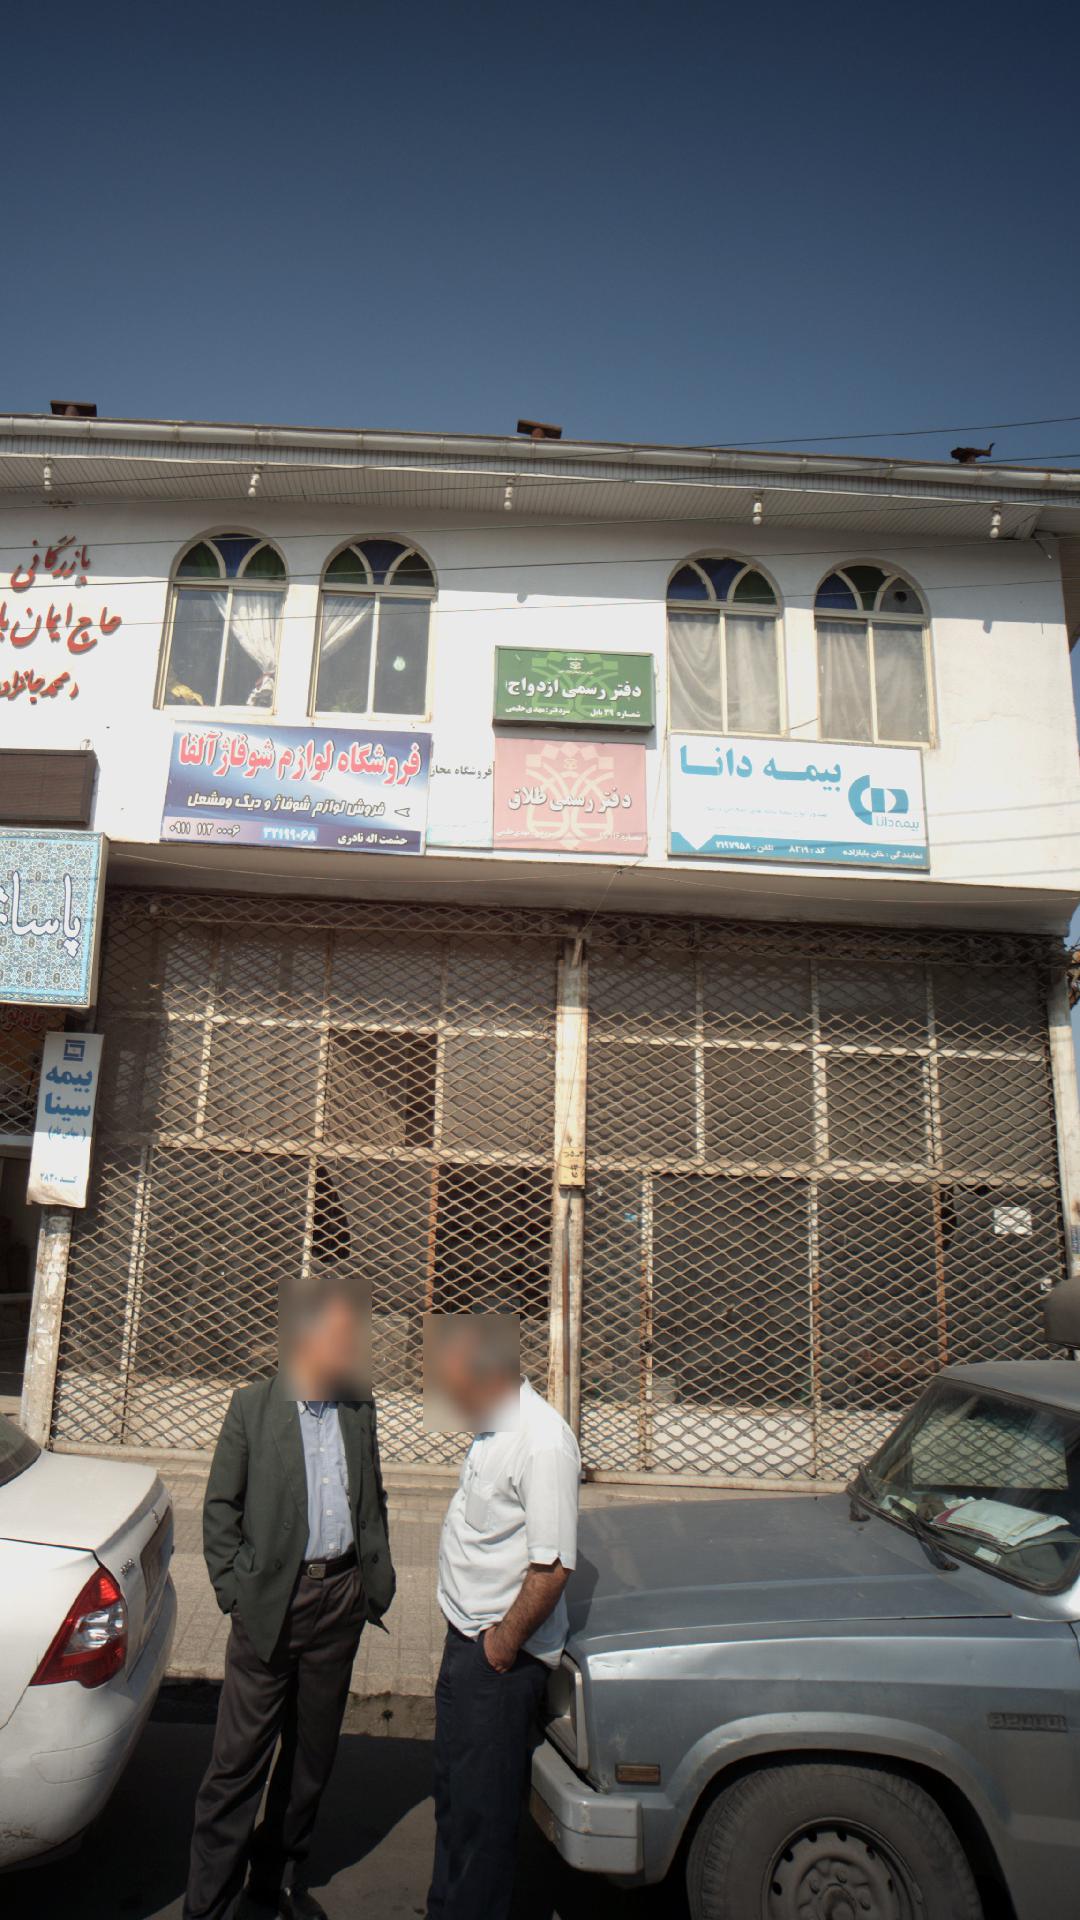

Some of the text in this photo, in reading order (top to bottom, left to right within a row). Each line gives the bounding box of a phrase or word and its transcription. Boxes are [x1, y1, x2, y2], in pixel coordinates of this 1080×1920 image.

[10, 535, 91, 592] بازرگانی
[10, 602, 73, 648] ایمان
[67, 606, 122, 654] حاج
[507, 677, 641, 700] دفتر رسمی ازدواج
[616, 711, 641, 719] شماره
[178, 730, 422, 785] فروشگاه لوازم شوفاژ آلفا
[680, 744, 842, 792] بیمه دانا
[455, 764, 493, 780] فروشگاه
[234, 795, 262, 810] دیگ
[272, 795, 311, 812] شوفاژ
[311, 798, 347, 818] لوازم
[348, 800, 387, 817] فروش
[507, 785, 632, 813] دفتر رسمی طلاق
[337, 831, 364, 845] نادری
[379, 834, 408, 845] حشمت
[0, 870, 81, 958] پاسا
[45, 1065, 93, 1093] بیمه
[44, 1092, 91, 1122] سینا
